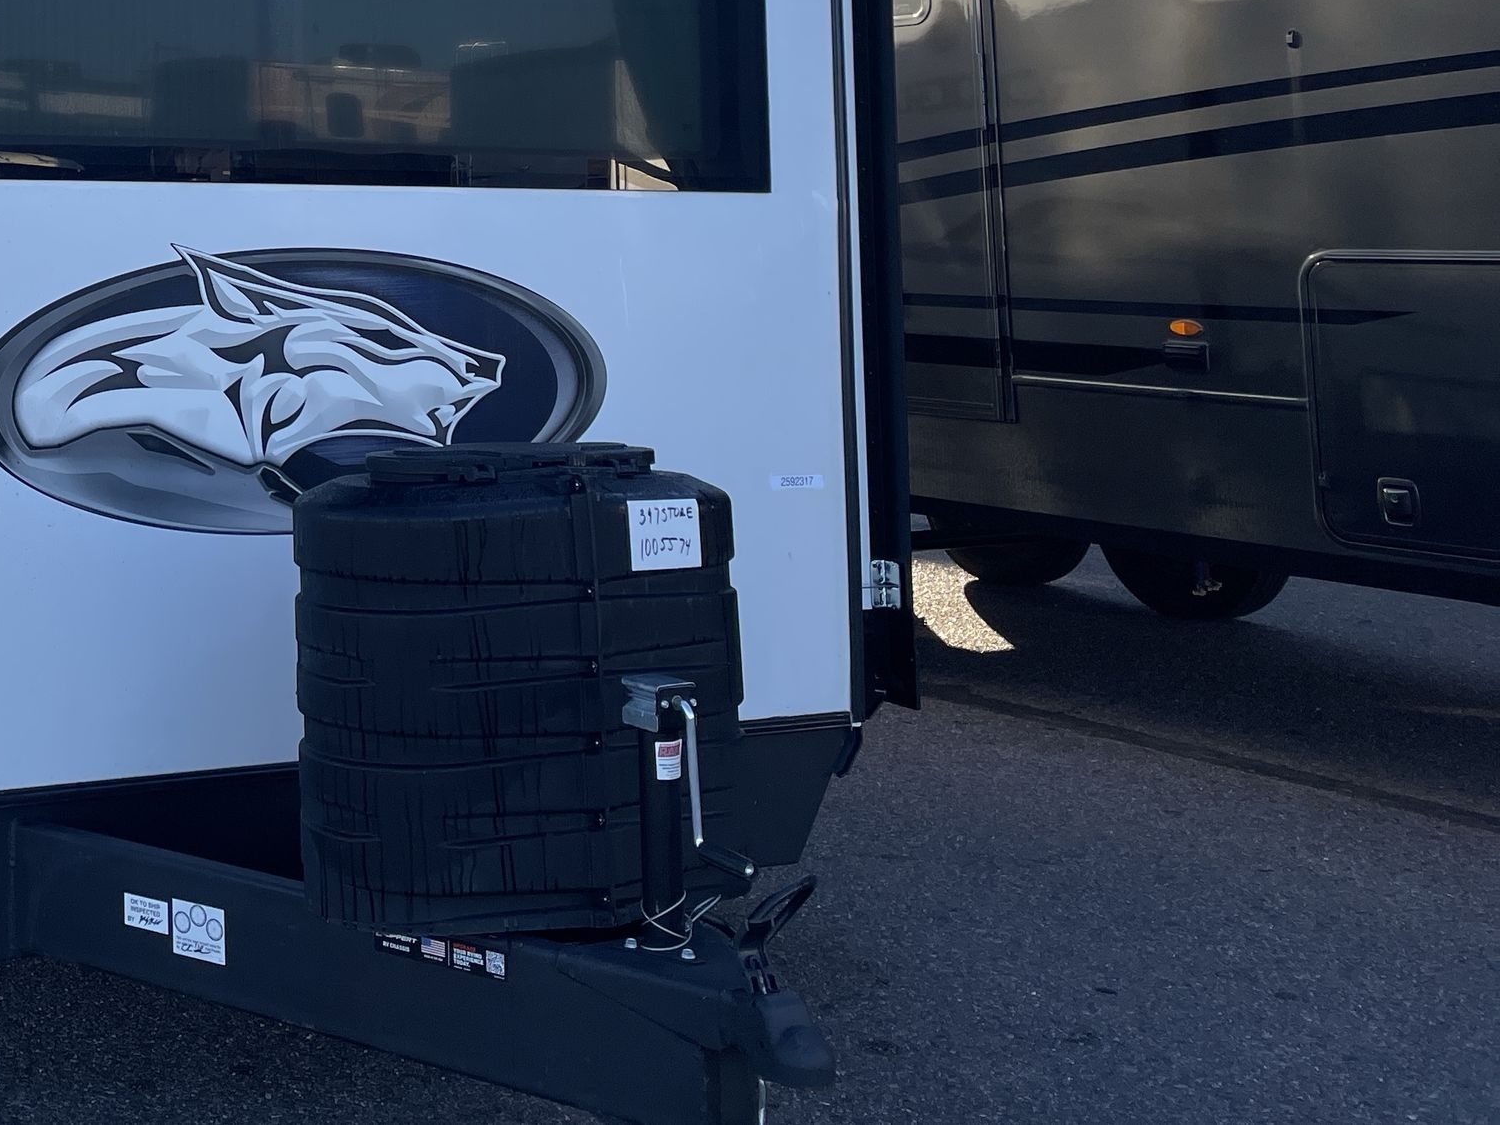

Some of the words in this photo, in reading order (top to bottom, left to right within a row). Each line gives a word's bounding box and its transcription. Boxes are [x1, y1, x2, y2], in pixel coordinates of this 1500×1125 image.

[780, 476, 814, 487] 2592317
[130, 898, 139, 906] OK
[130, 906, 161, 917] INSPECTED
